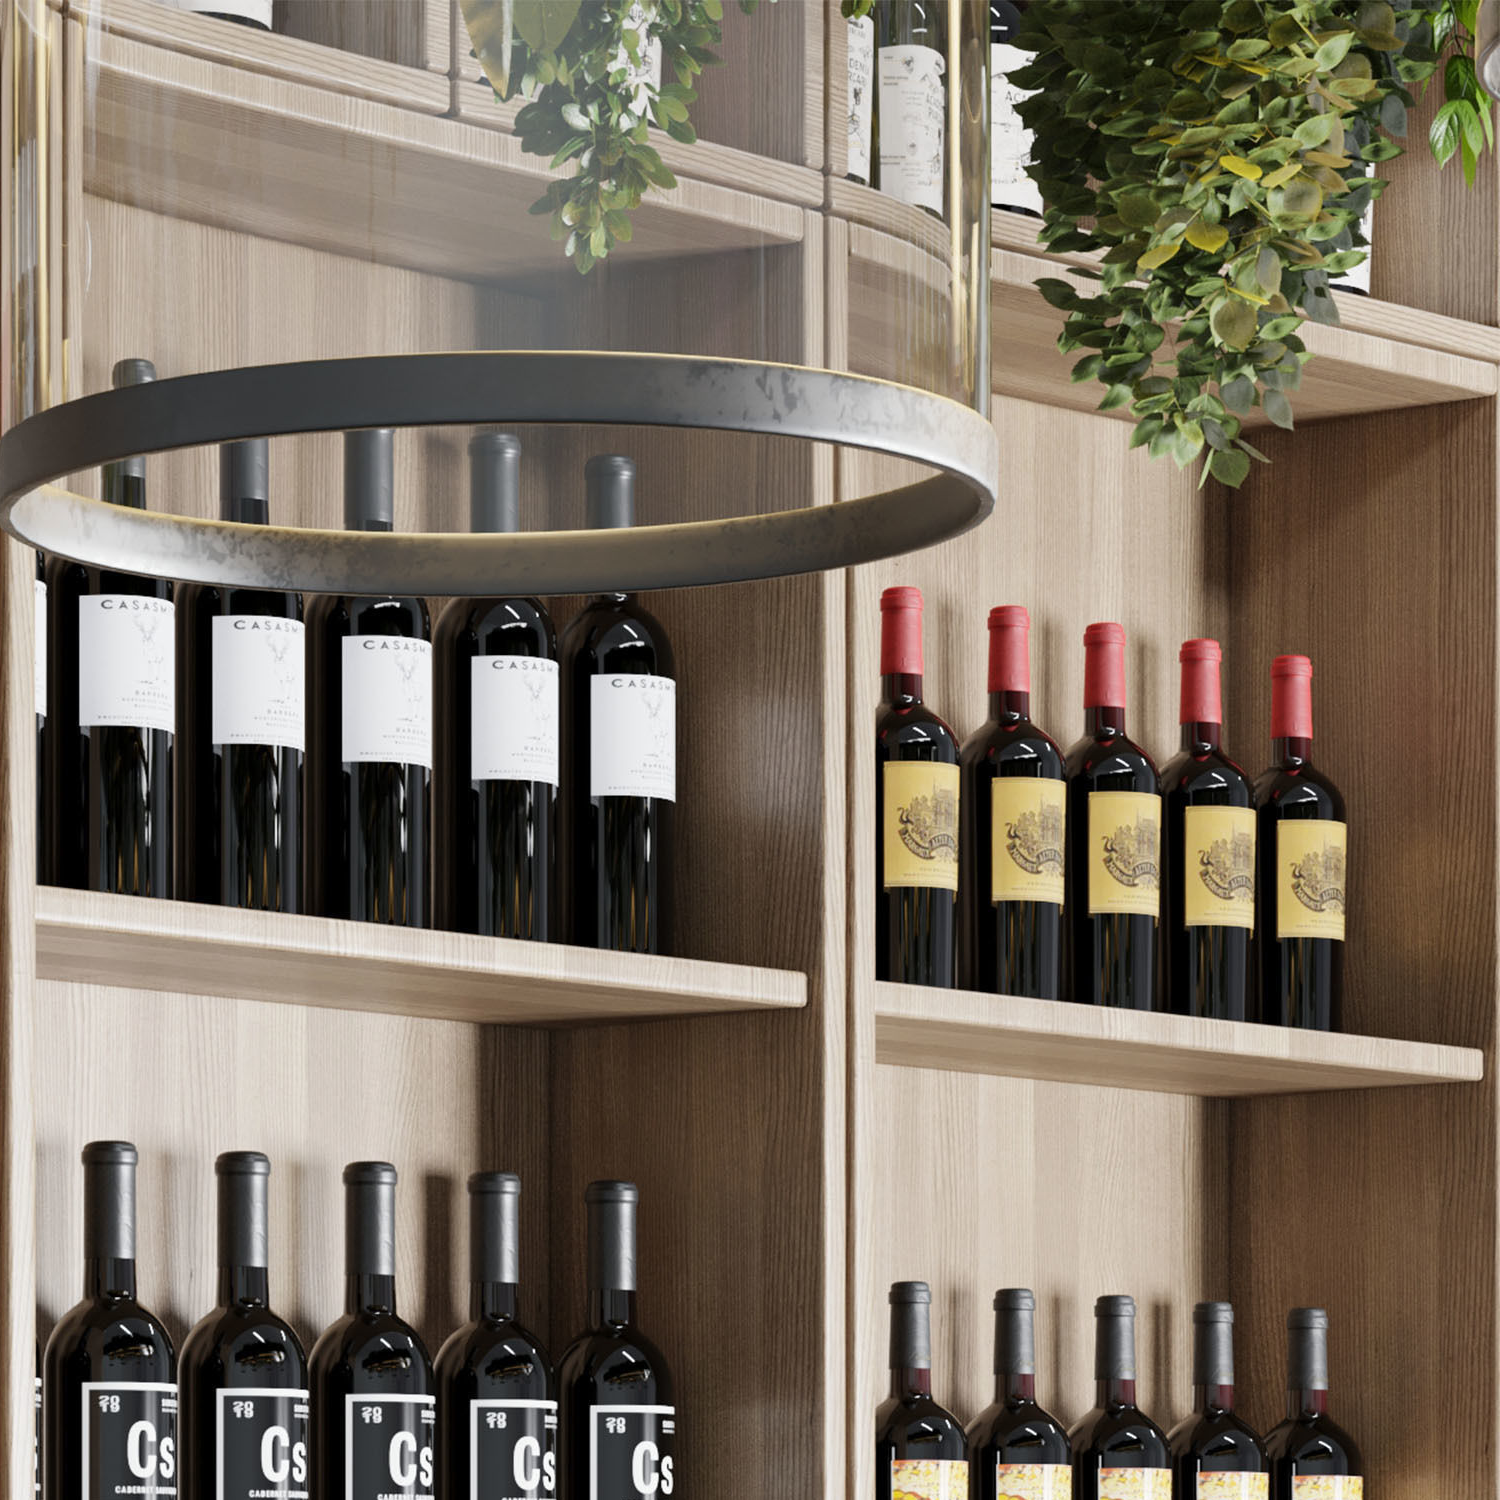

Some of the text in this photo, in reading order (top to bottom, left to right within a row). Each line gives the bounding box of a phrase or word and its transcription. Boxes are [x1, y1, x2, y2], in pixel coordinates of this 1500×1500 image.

[127, 1420, 175, 1479] Cs
[261, 1425, 307, 1483] Cs
[388, 1431, 433, 1487] Cs
[513, 1436, 556, 1491] Cs
[632, 1440, 674, 1494] Cs
